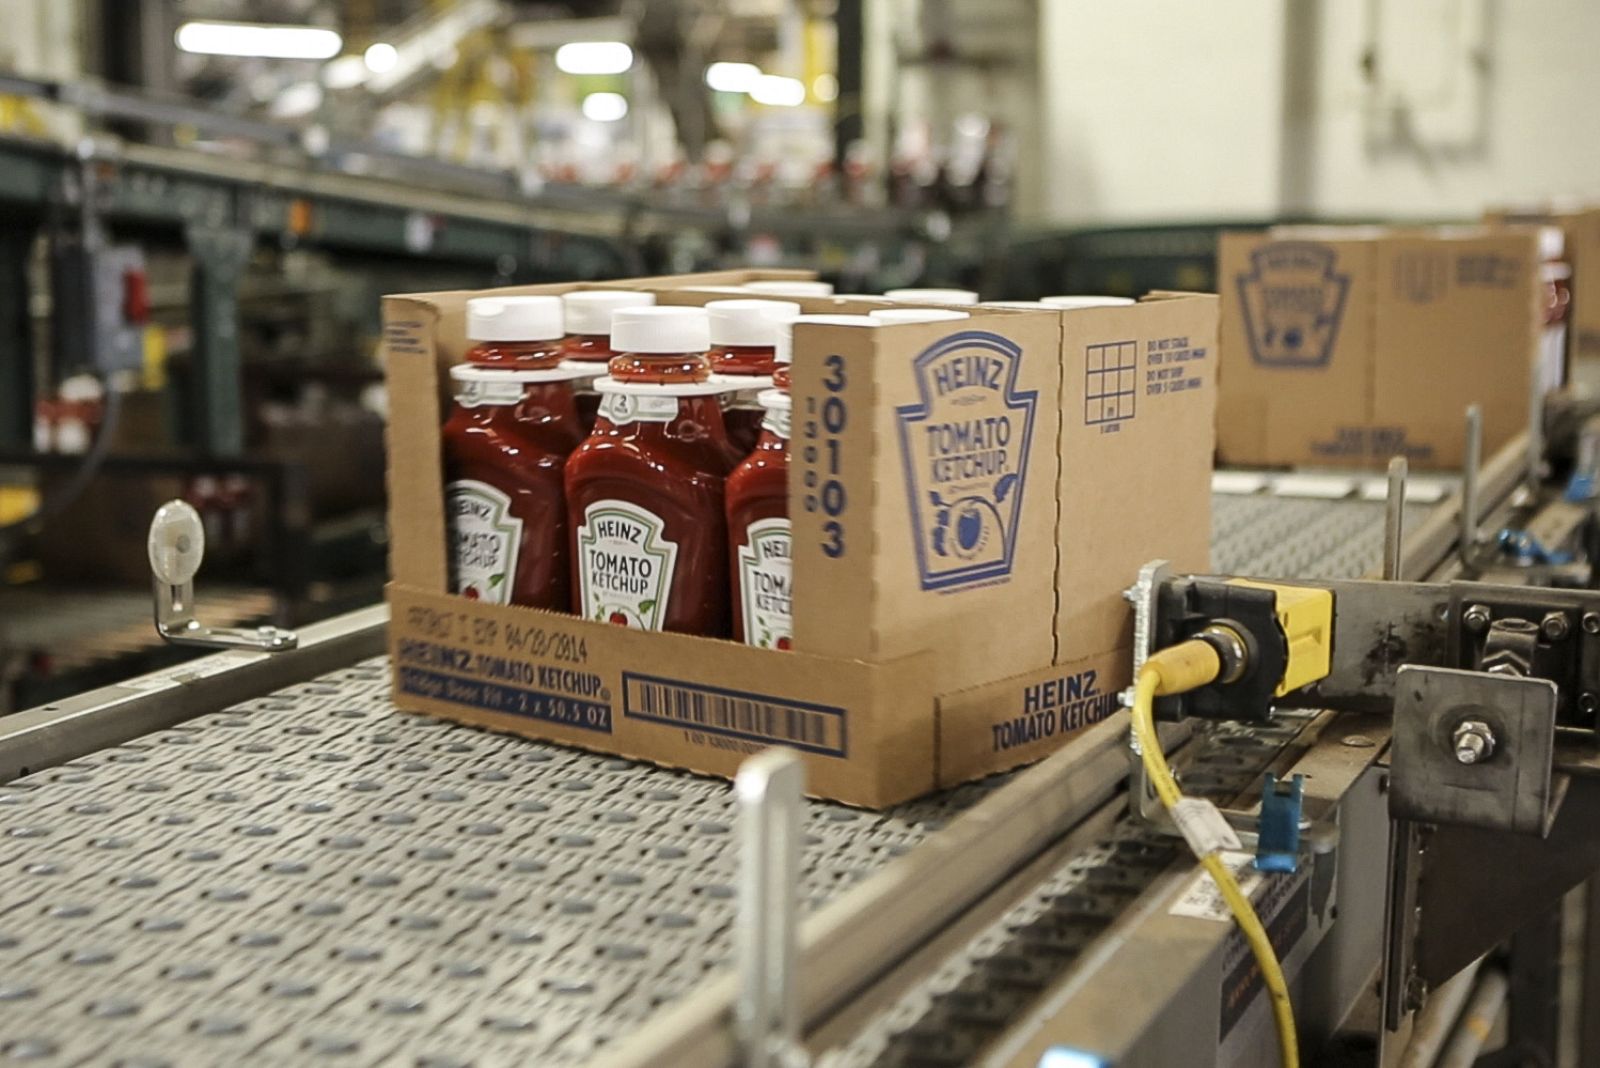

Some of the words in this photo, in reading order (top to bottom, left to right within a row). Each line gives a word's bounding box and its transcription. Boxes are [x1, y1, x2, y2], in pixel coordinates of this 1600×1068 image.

[934, 356, 1004, 396] HEINZ
[619, 395, 627, 407] 2
[926, 415, 1012, 454] TOMATO
[821, 355, 846, 559] 30103
[598, 520, 642, 544] HEINZ
[590, 549, 652, 578] TOMATO
[762, 540, 793, 558] HEI
[592, 571, 648, 595] KETCHUP
[753, 570, 793, 597] TOM
[476, 653, 534, 685] TOMATO
[1023, 670, 1097, 714] HEINZ
[518, 692, 528, 712] 2
[548, 698, 580, 722] 50.5
[586, 706, 609, 728] OZ
[992, 709, 1056, 751] TOMATO
